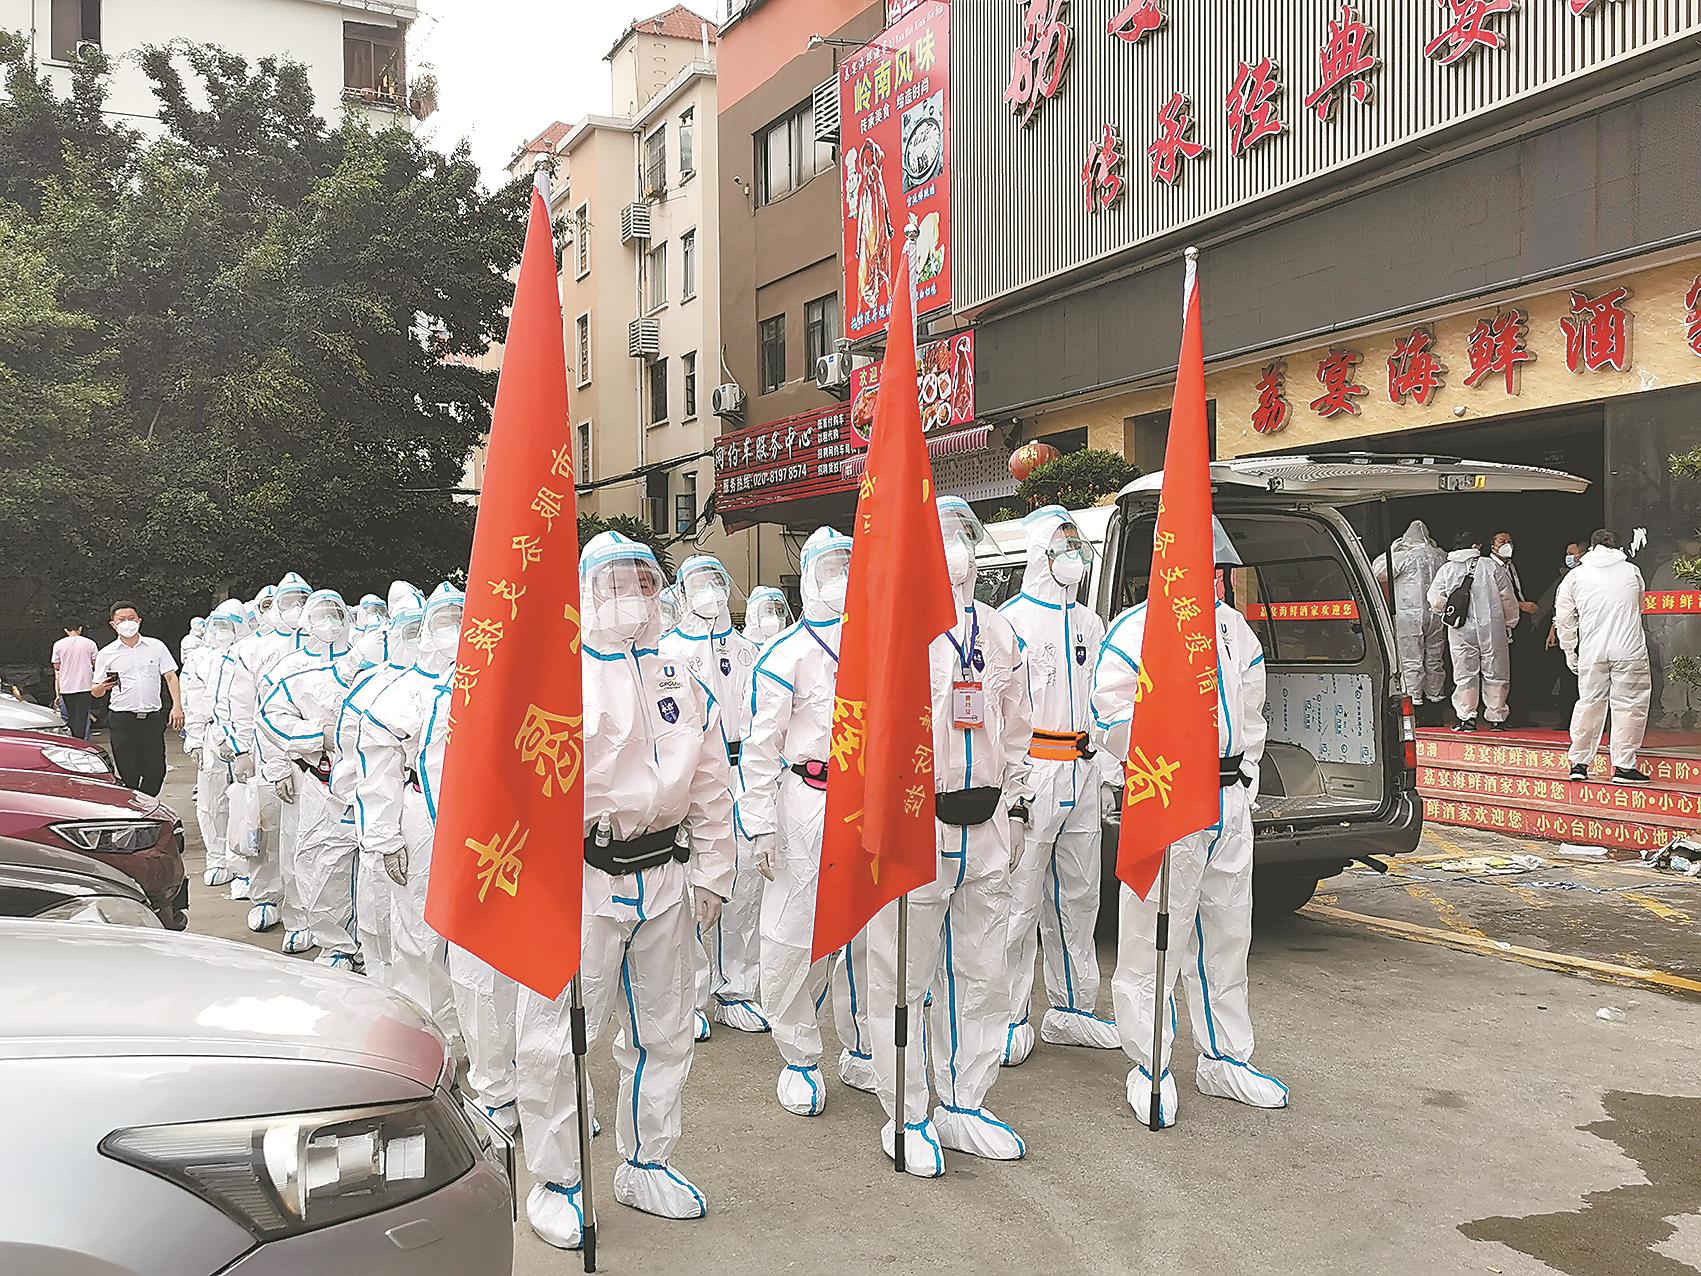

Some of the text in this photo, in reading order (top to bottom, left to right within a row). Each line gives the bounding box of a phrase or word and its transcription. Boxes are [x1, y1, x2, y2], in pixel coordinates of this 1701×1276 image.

[854, 27, 936, 115] 岭南风味
[859, 363, 884, 386] 欢迎
[817, 443, 857, 460] 招聘网约车司
[1259, 603, 1352, 617] 荔宴海鲜酒家欢迎您
[1644, 593, 1701, 610] 宴海鲜
[1463, 743, 1607, 773] 荔宴海鲜酒家欢您
[1423, 768, 1701, 815] 荔宴海鲜酒家欢迎您 小心台阶·小心
[1426, 799, 1522, 829] 鲜酒家欢迎您
